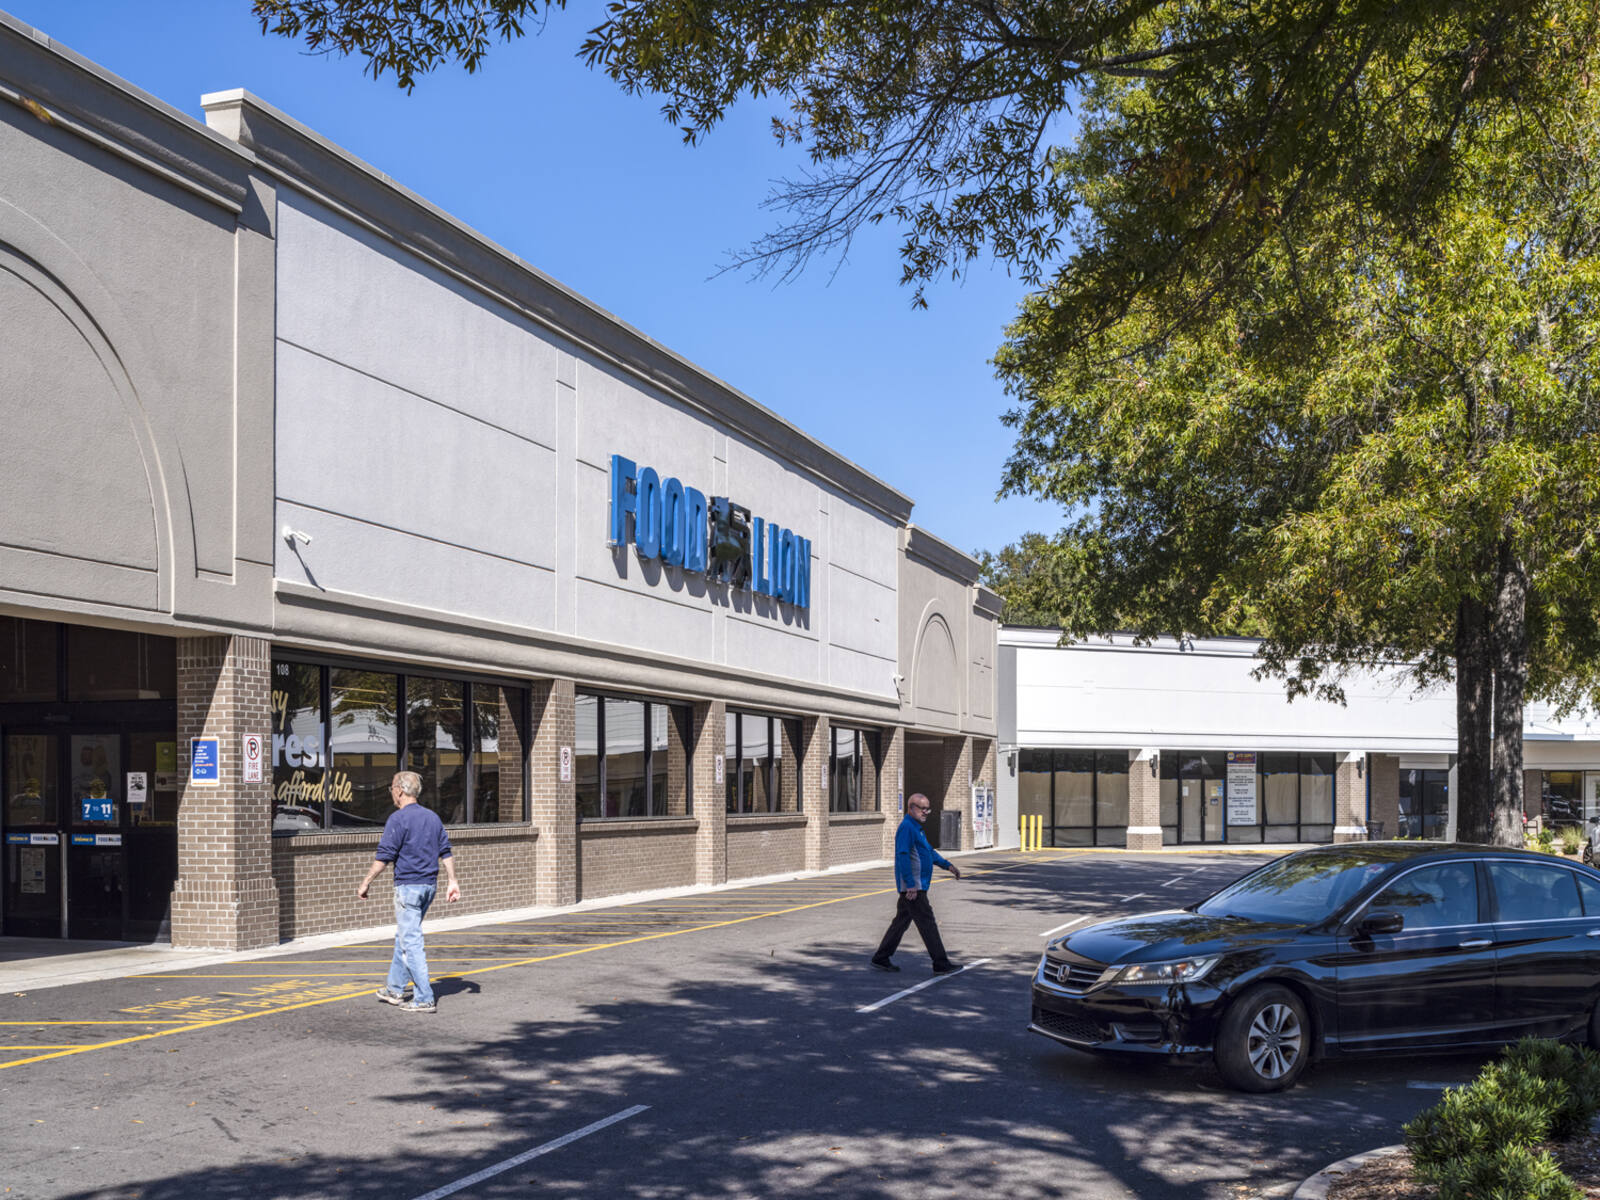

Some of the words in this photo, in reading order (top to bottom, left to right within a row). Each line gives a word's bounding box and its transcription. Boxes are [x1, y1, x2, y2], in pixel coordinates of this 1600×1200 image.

[611, 455, 708, 573] FOOD
[753, 517, 811, 609] LION
[271, 690, 289, 730] sy
[272, 722, 334, 768] resh
[84, 804, 91, 814] 7
[100, 803, 111, 814] 11
